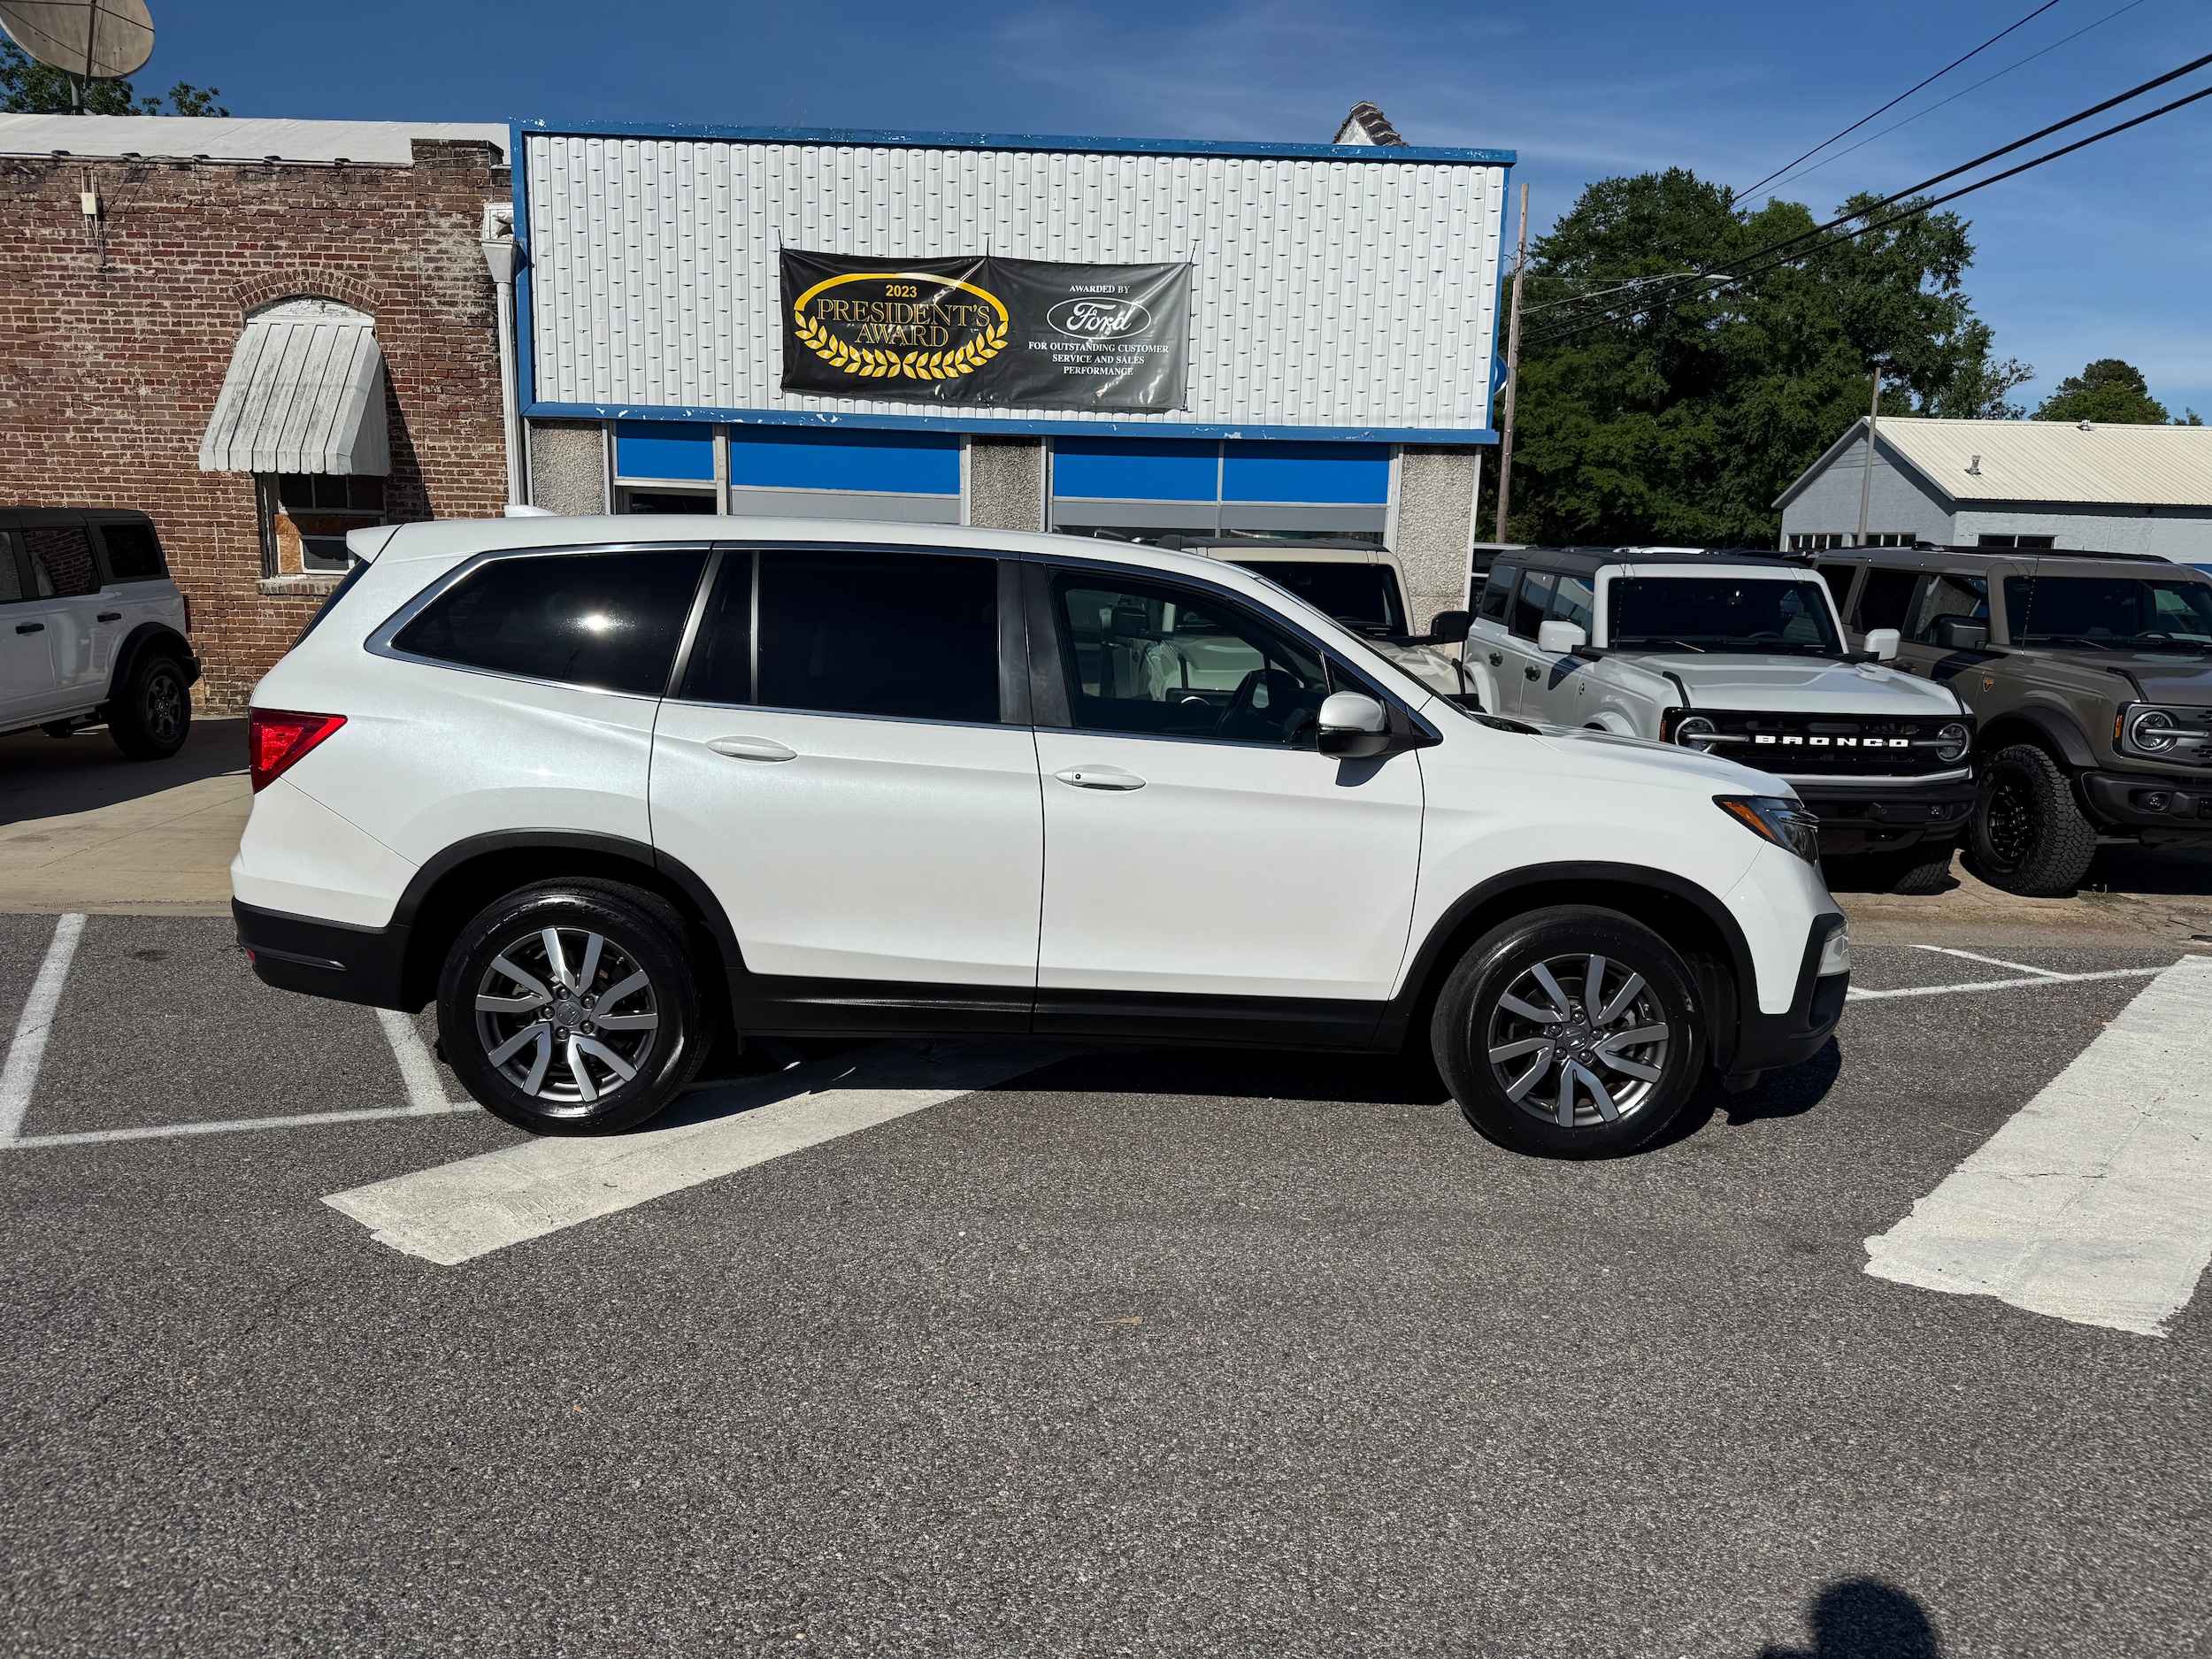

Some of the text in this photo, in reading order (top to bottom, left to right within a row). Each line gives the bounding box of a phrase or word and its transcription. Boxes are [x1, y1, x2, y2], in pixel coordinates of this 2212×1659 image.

[885, 284, 918, 298] 2023
[1118, 285, 1131, 294] BY
[816, 298, 991, 327] PRESIDENT'S
[1066, 302, 1133, 331] Ford
[854, 322, 949, 348] AWARD
[1028, 342, 1170, 353] FOR OUTSTANDING CUSTOMER
[1052, 354, 1145, 365] SERVICE AND SALES
[1064, 365, 1134, 376] PERFORMANCE
[1755, 734, 1909, 748] BRONCO
